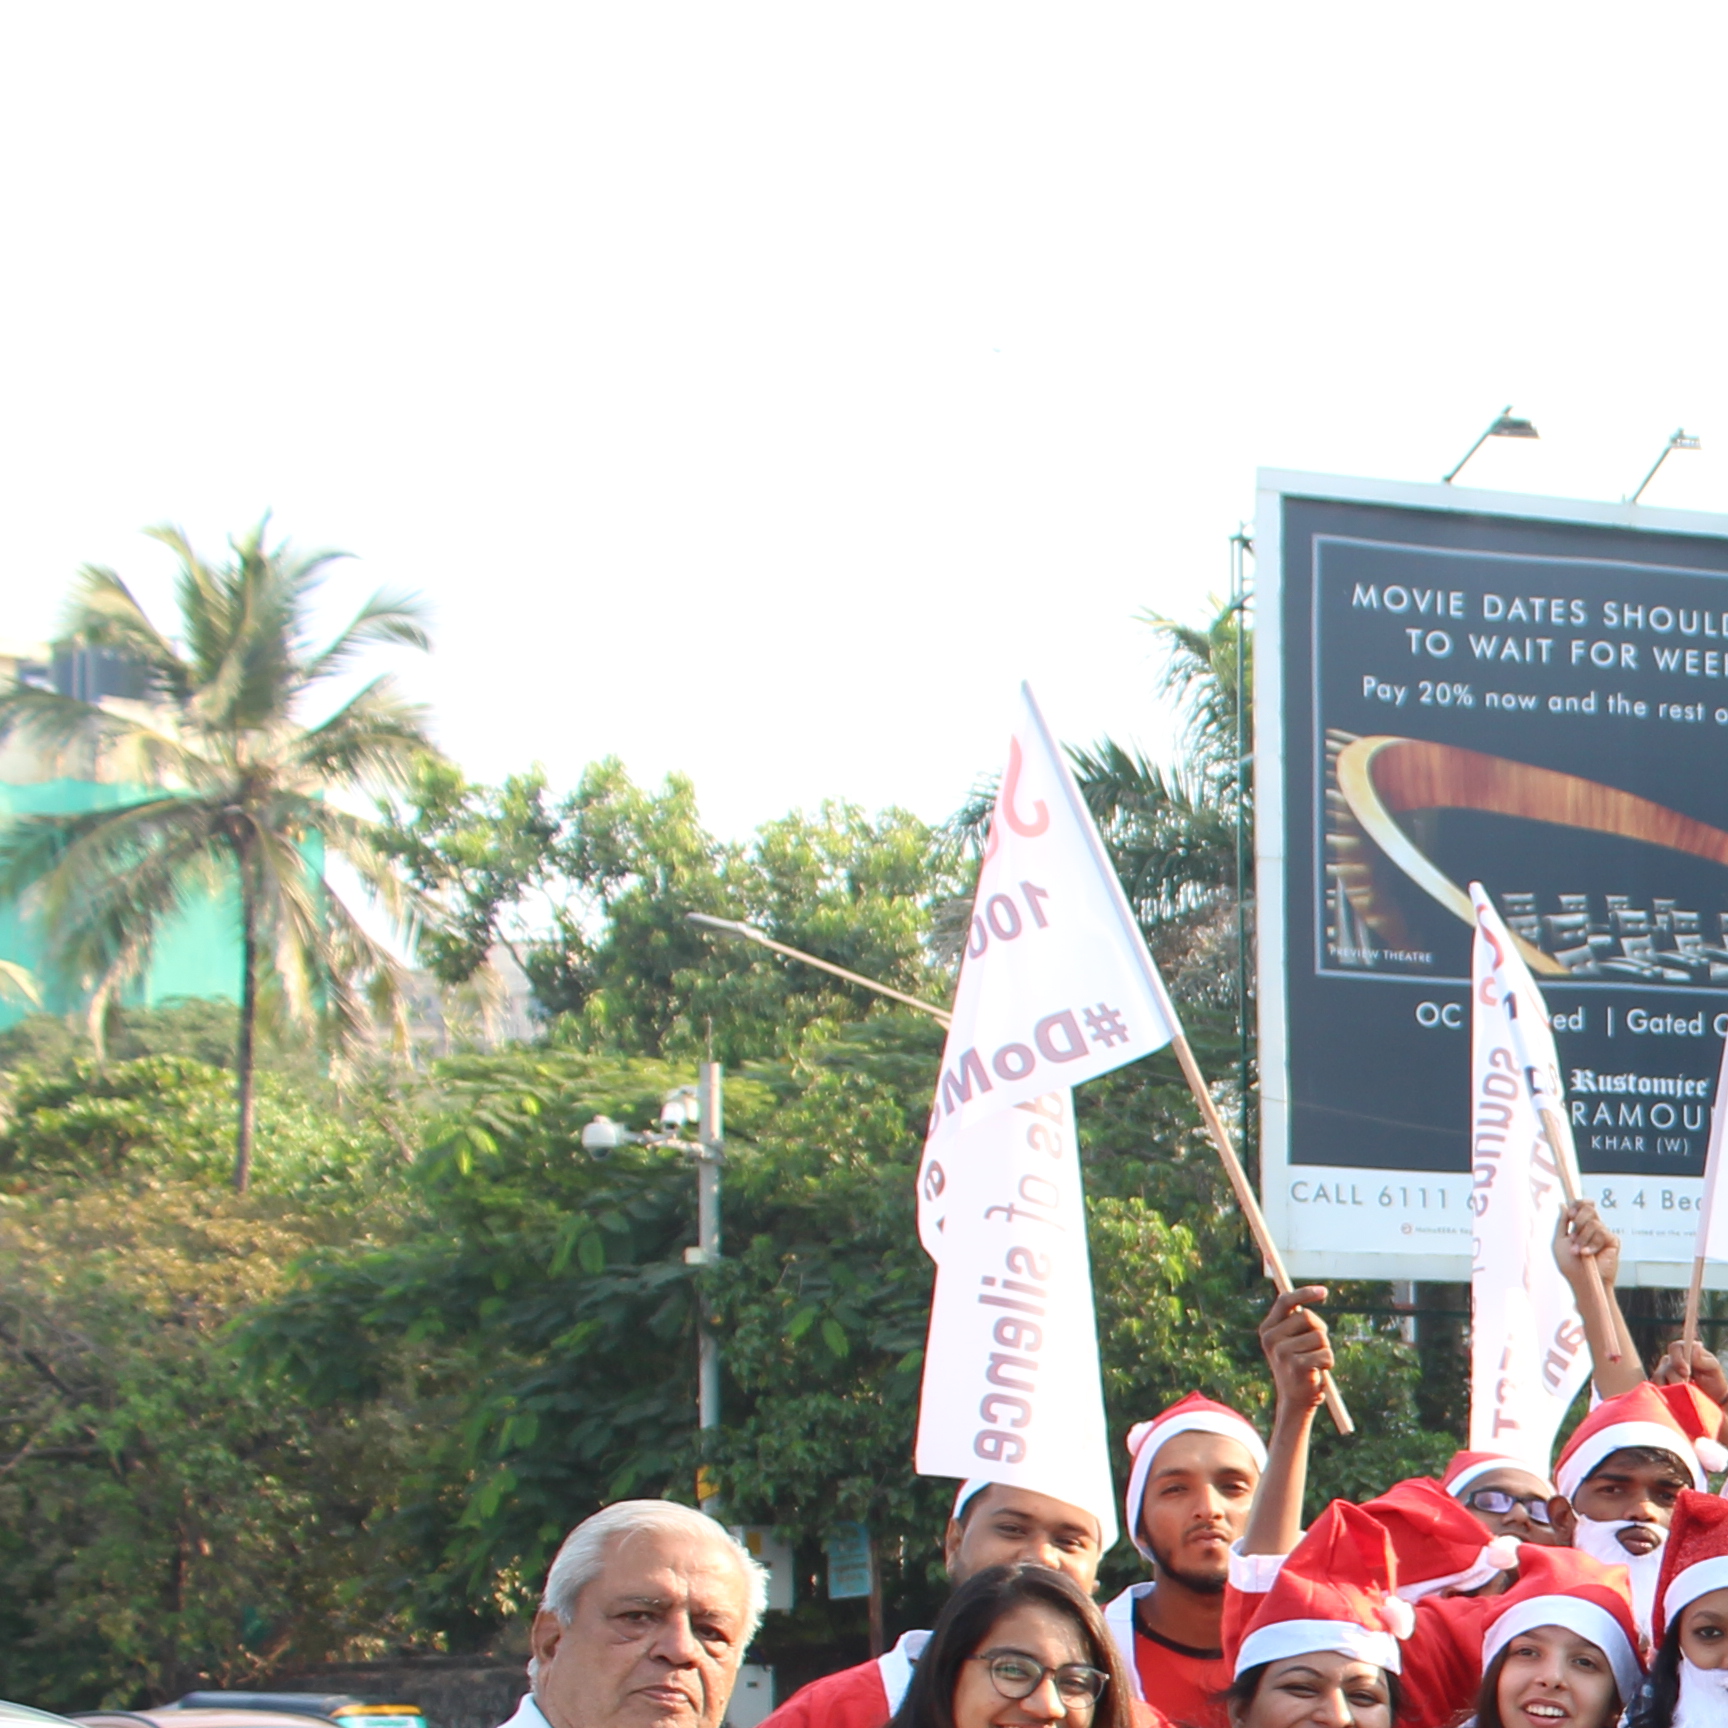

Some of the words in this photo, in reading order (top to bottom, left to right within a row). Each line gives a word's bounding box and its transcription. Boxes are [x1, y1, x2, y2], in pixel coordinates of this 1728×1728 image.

[1352, 583, 1466, 619] MOVIE
[1483, 594, 1587, 626] DATES
[1405, 628, 1451, 658] TO
[1469, 634, 1553, 664] WAIT
[1571, 640, 1638, 669] FOR
[1362, 675, 1406, 706] Pay
[1418, 680, 1473, 706] 20%
[1485, 692, 1537, 712] now
[1548, 690, 1597, 714] and
[1607, 692, 1648, 717] the
[1659, 702, 1704, 721] rest
[1383, 950, 1433, 962] THEATRE
[1416, 1001, 1463, 1028] OC
[1626, 1008, 1703, 1035] Gated
[1570, 1068, 1710, 1098] Rustomjee
[1591, 1135, 1645, 1151] KHAR
[1656, 1137, 1689, 1156] (W)
[1291, 1181, 1363, 1206] CALL
[1378, 1185, 1447, 1209] 6111
[1632, 1189, 1645, 1209] 4
